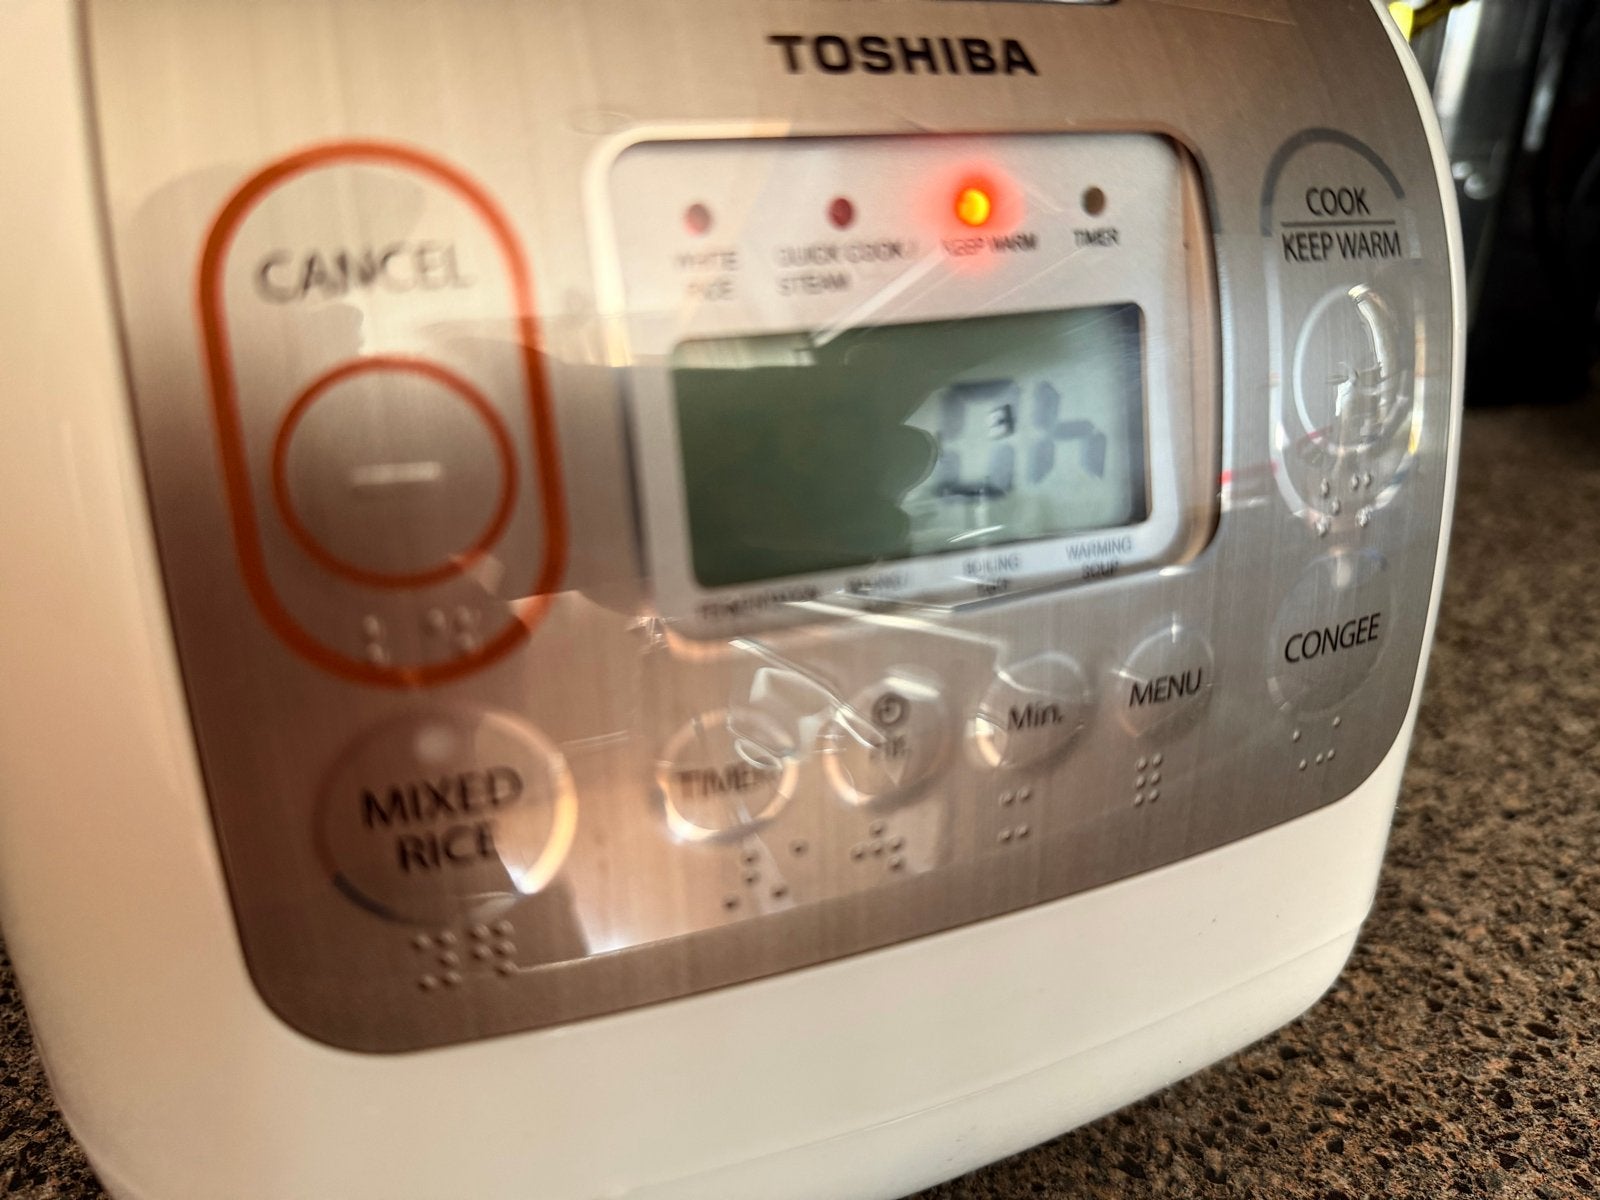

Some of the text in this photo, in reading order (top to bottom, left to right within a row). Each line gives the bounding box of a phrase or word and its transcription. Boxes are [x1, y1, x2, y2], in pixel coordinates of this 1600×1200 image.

[768, 34, 1040, 77] TOSHIBA
[1306, 186, 1370, 217] COOK
[1074, 228, 1120, 247] TIMER
[1283, 228, 1402, 263] KEEP WARM
[253, 240, 476, 304] CANCEL
[1065, 535, 1134, 562] WARMING
[1284, 612, 1381, 664] CONGEE
[1129, 668, 1203, 708] MENU
[1007, 702, 1064, 731] Min.
[360, 765, 524, 831] MIXED
